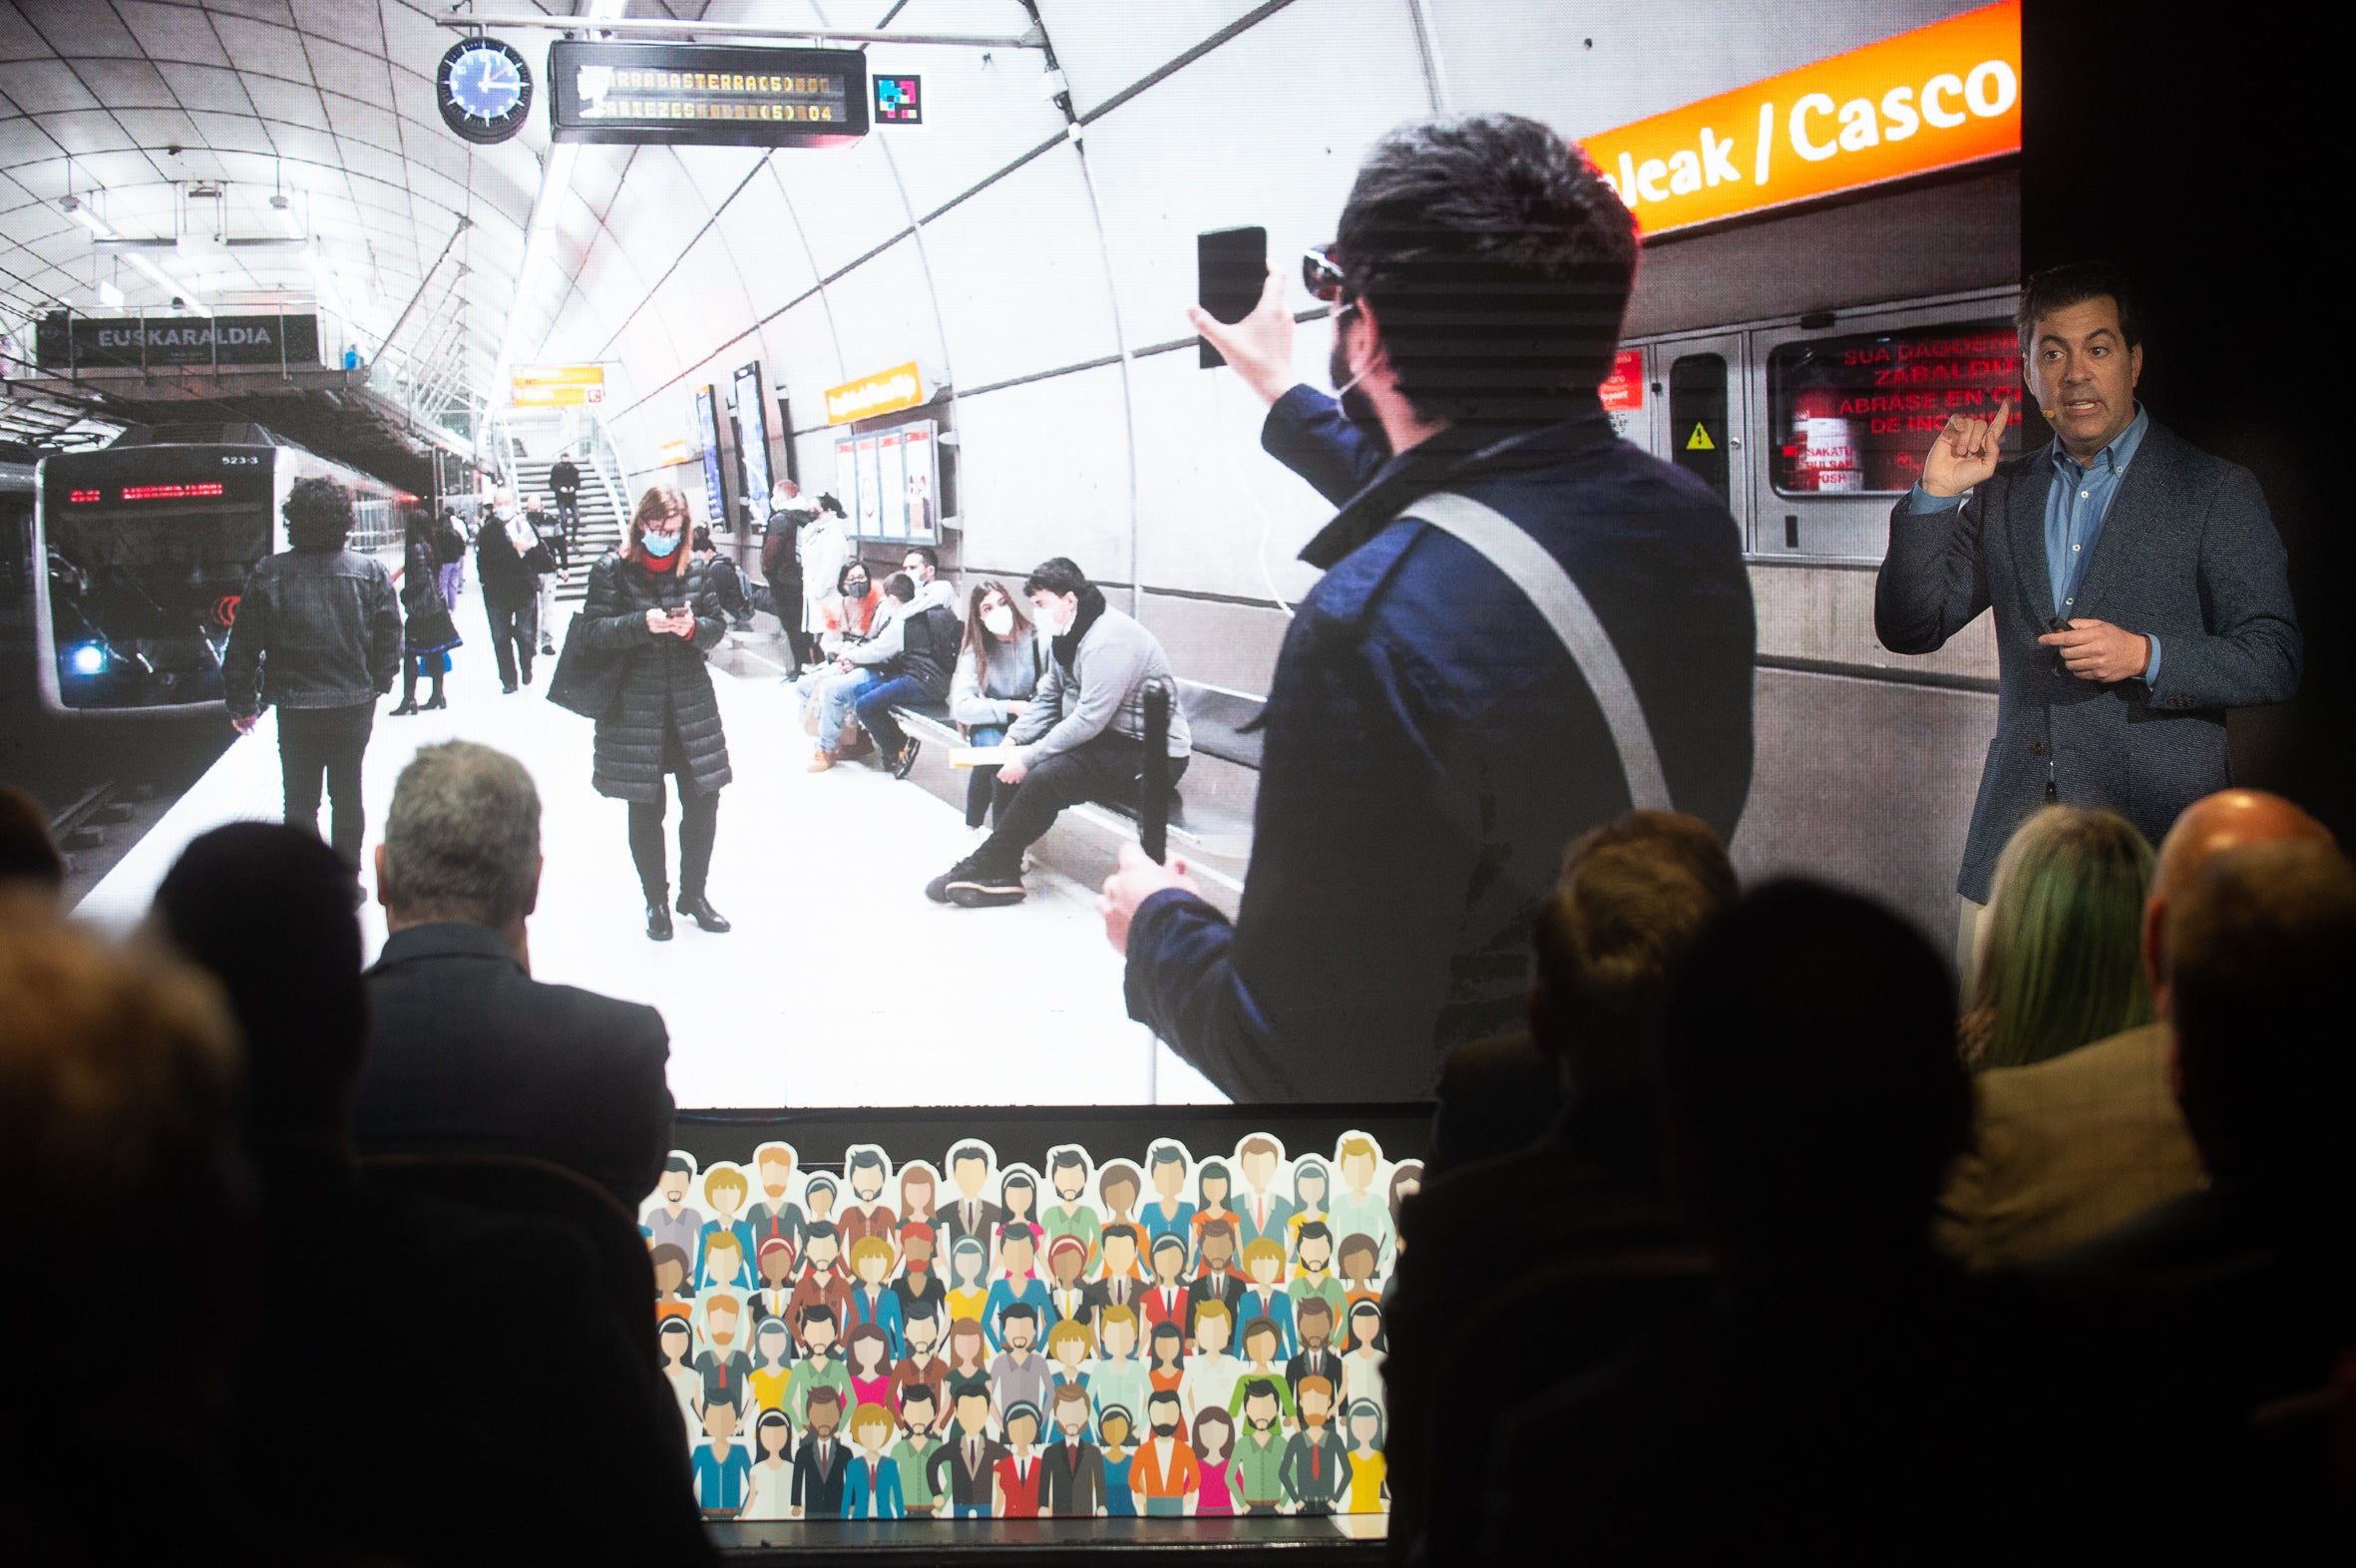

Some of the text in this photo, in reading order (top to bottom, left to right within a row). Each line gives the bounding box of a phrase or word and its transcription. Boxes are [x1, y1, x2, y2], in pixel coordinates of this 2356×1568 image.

[1788, 60, 2018, 162] Casco
[99, 327, 272, 348] EUSKARALDIA
[1843, 346, 1891, 366] SUA
[1874, 357, 2015, 387] ZABALDU
[1839, 392, 1938, 415] ABRASE
[1946, 389, 1984, 407] EN
[1870, 417, 1902, 435] DE
